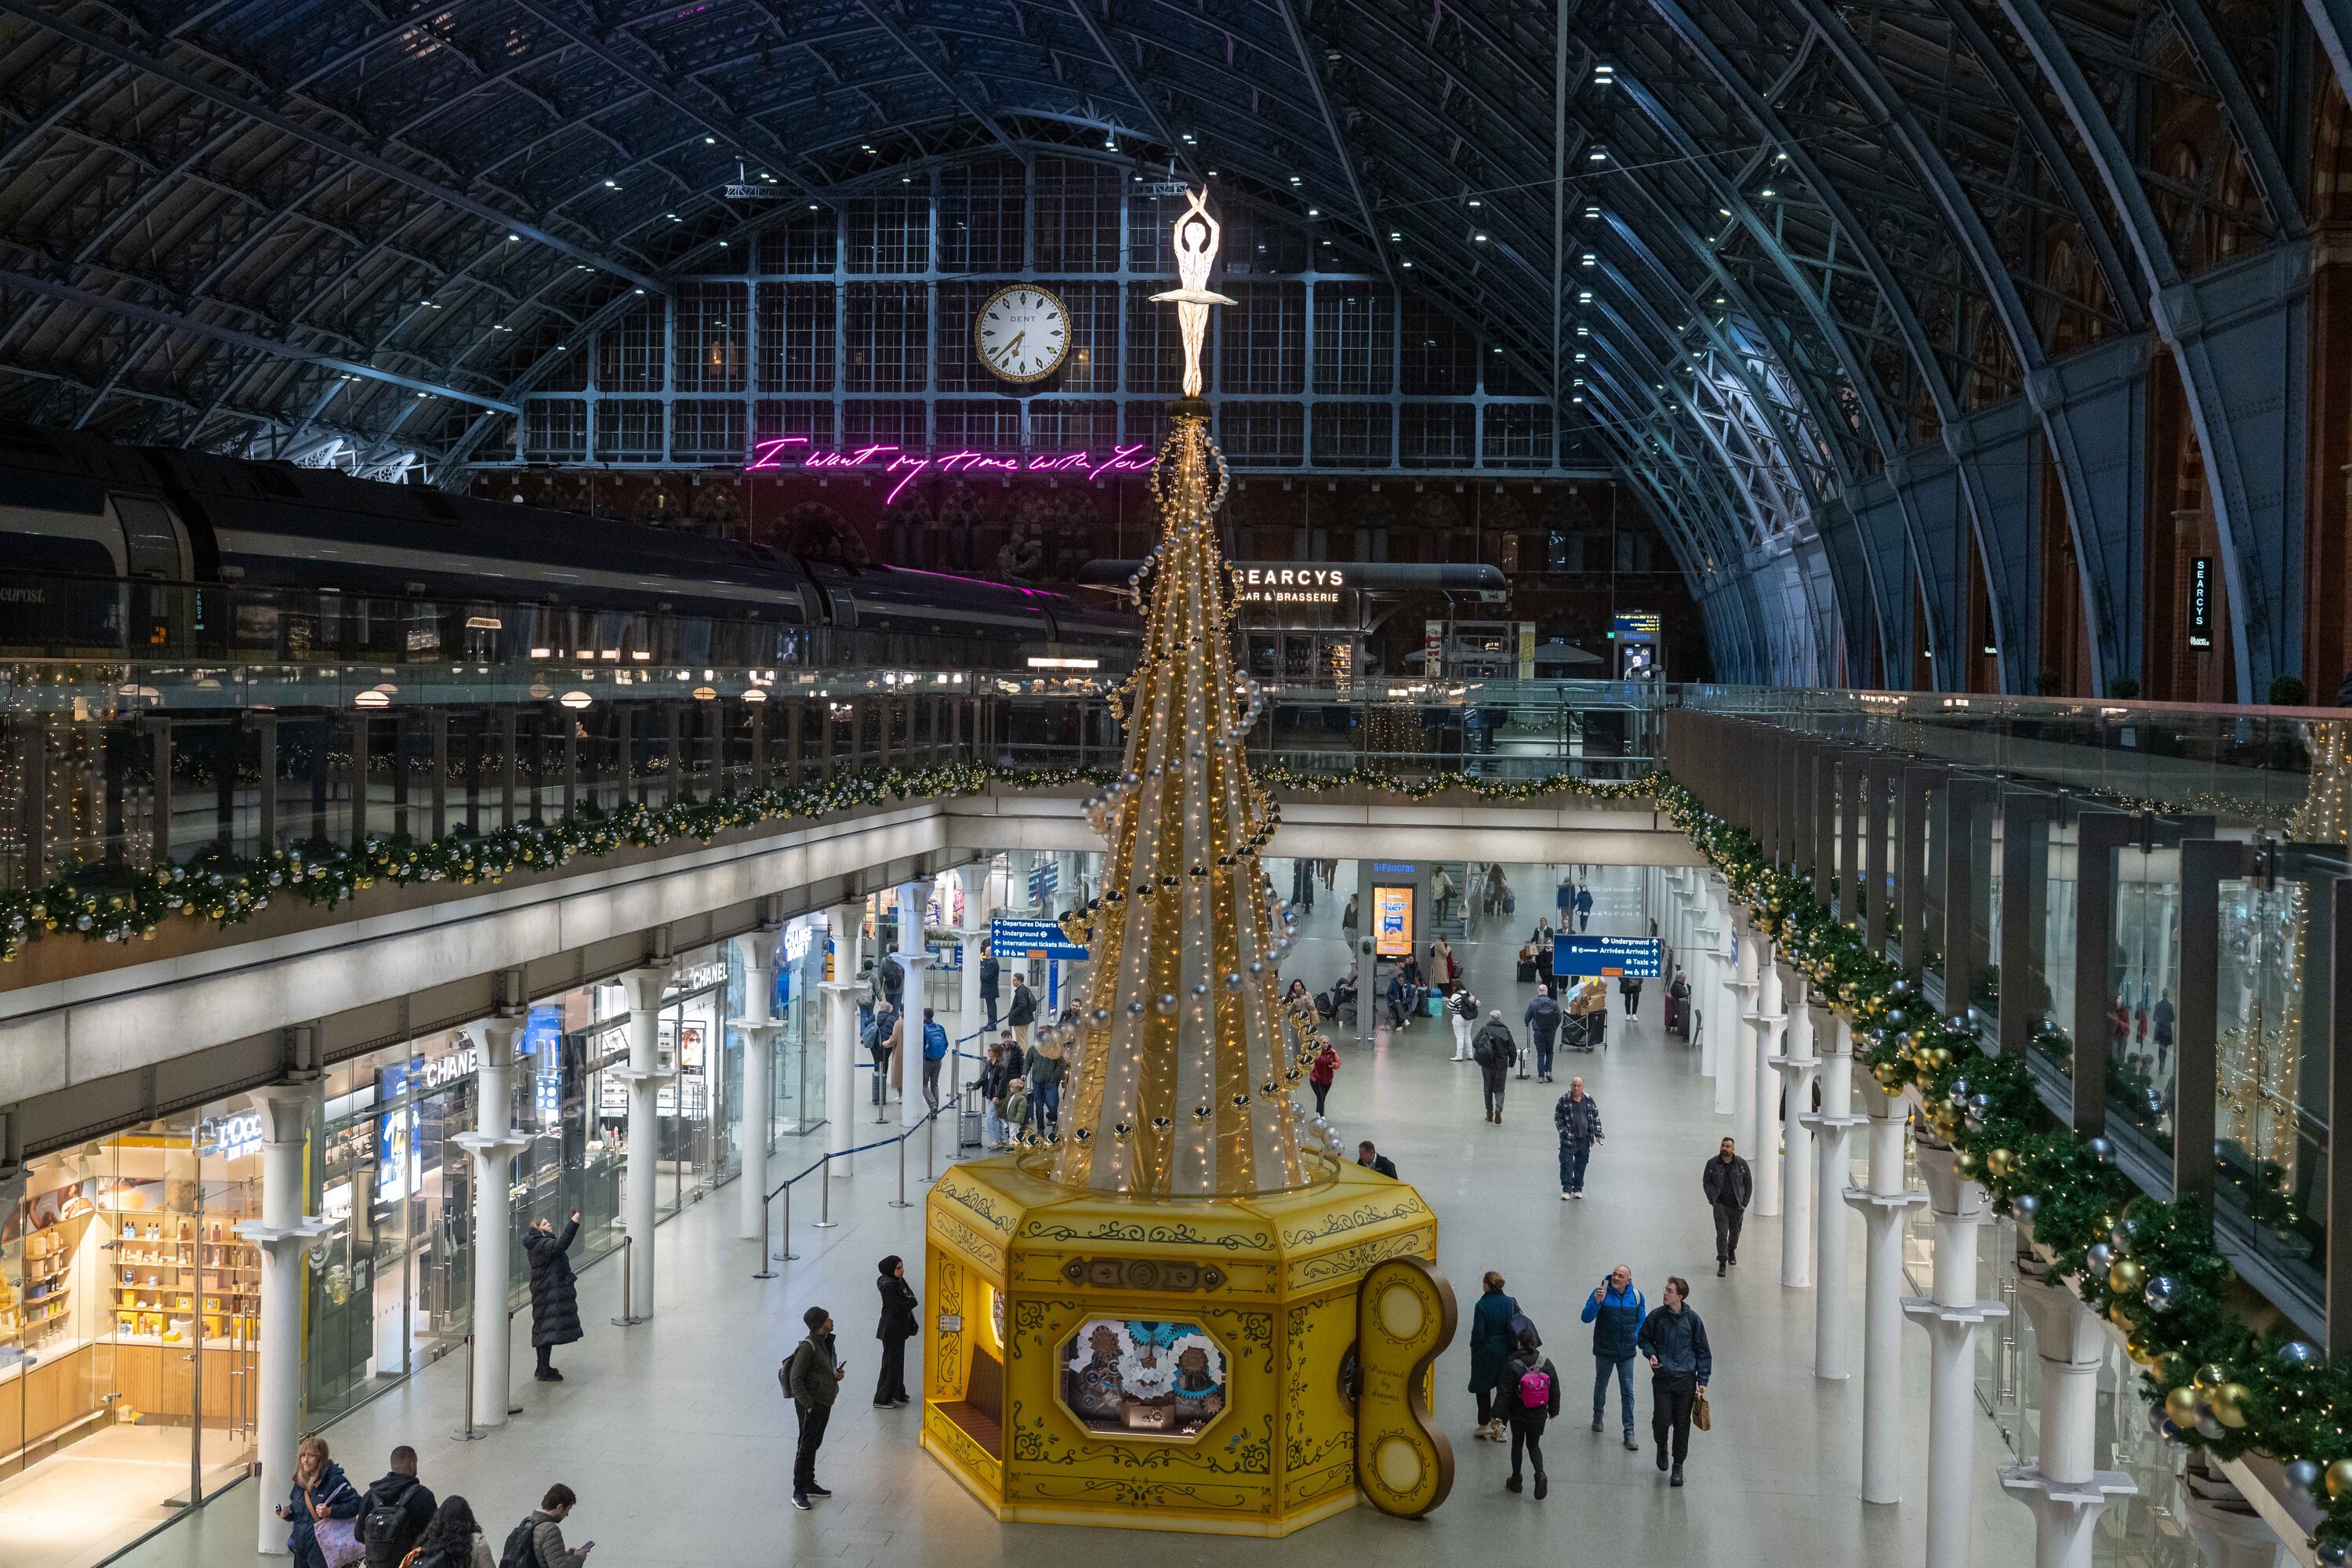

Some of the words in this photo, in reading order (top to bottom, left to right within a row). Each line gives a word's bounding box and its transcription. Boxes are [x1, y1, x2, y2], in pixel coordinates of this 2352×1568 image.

[746, 438, 808, 470] I
[805, 445, 898, 466] want
[1029, 452, 1091, 470] with
[0, 586, 45, 603] eurost
[1264, 592, 1272, 601] &
[1276, 592, 1339, 602] BRASSERIE
[2196, 561, 2205, 625] SEARCYS
[1382, 863, 1415, 873] Pancras
[693, 962, 728, 990] CHANEL
[426, 1049, 477, 1088] CHANE
[1368, 1362, 1405, 1379] Powered
[1381, 1377, 1392, 1391] by
[1372, 1388, 1399, 1402] dreams
